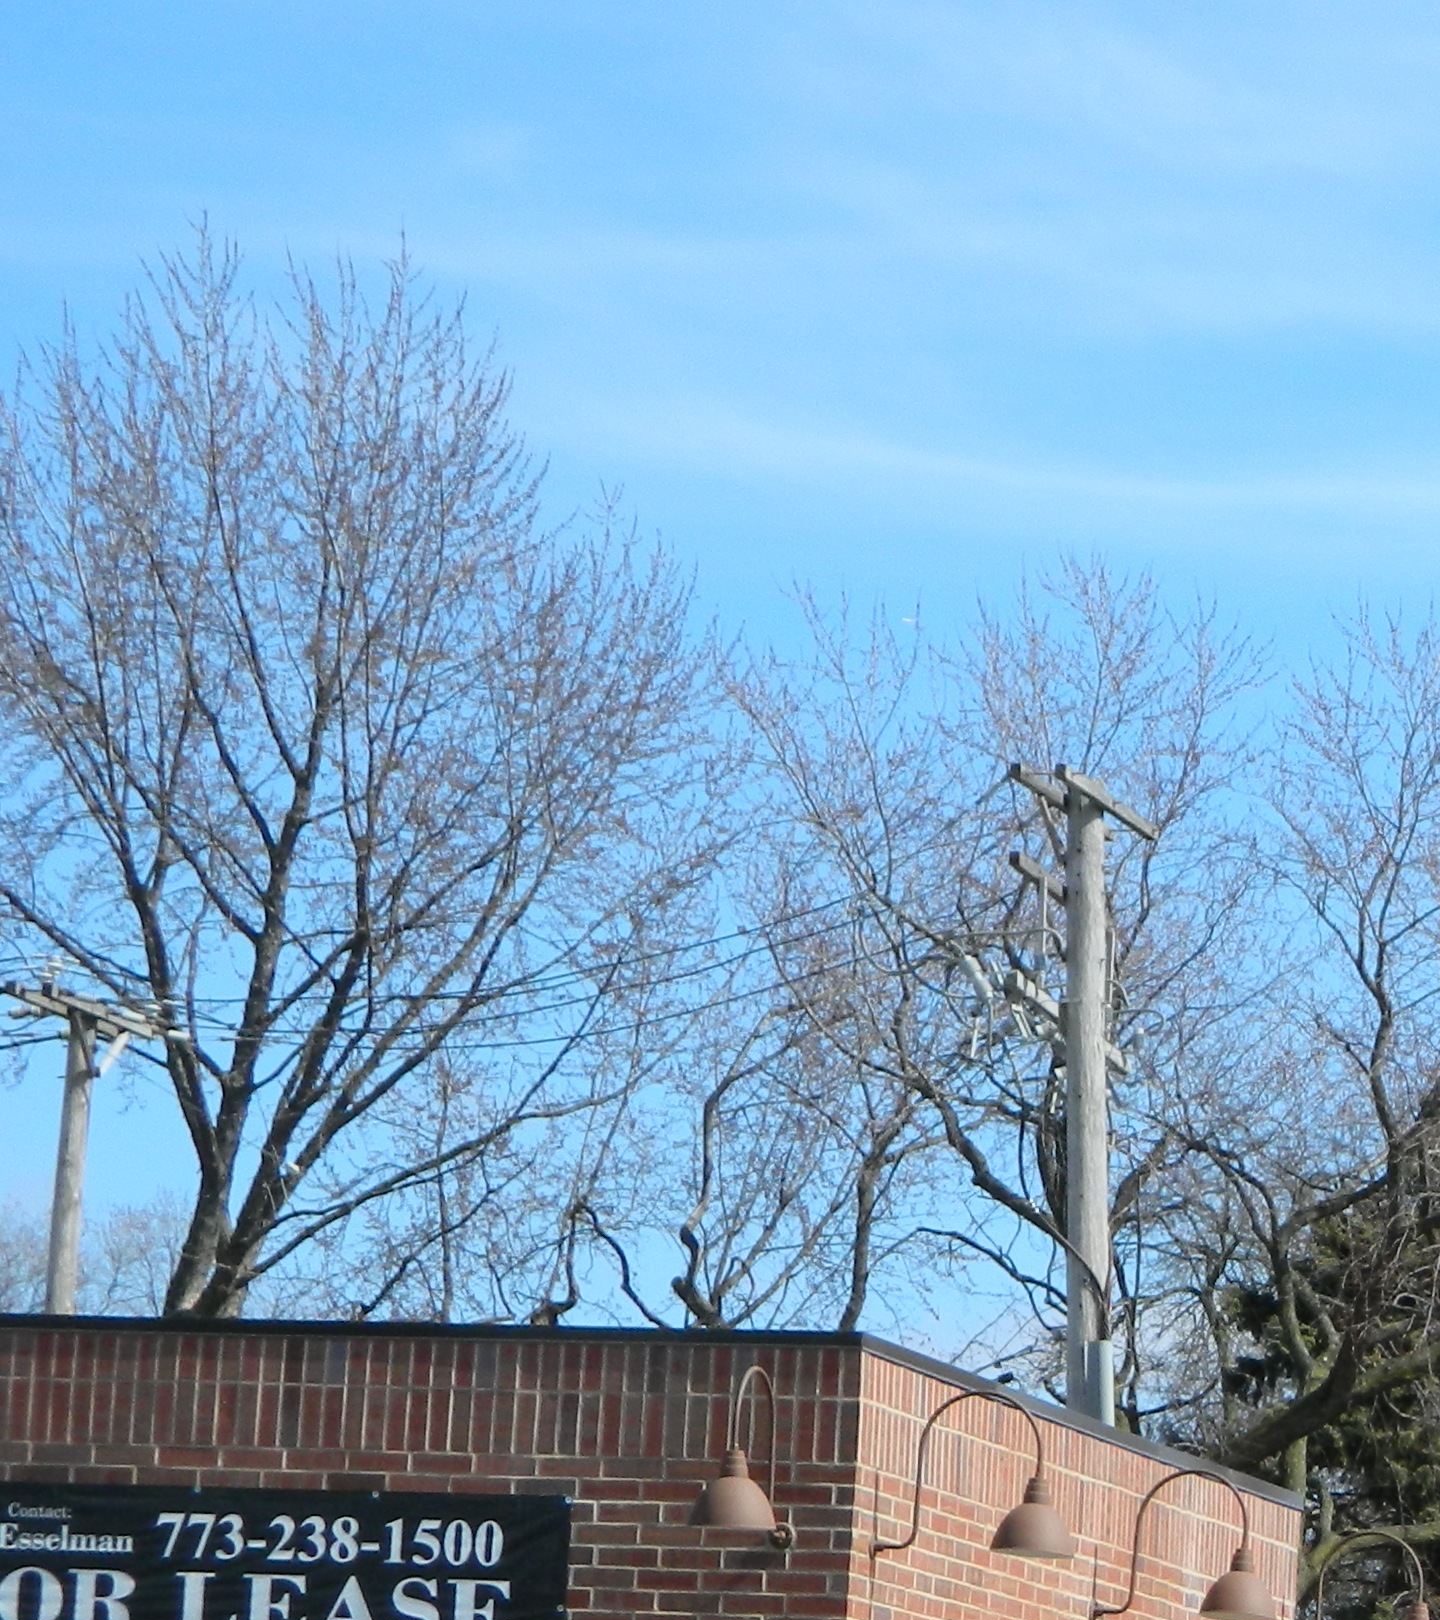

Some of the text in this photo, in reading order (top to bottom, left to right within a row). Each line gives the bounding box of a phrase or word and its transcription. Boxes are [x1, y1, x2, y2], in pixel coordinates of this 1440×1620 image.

[7, 1501, 72, 1519] Contact:
[0, 1522, 134, 1553] Esselman
[155, 1512, 505, 1567] 773-238-1500
